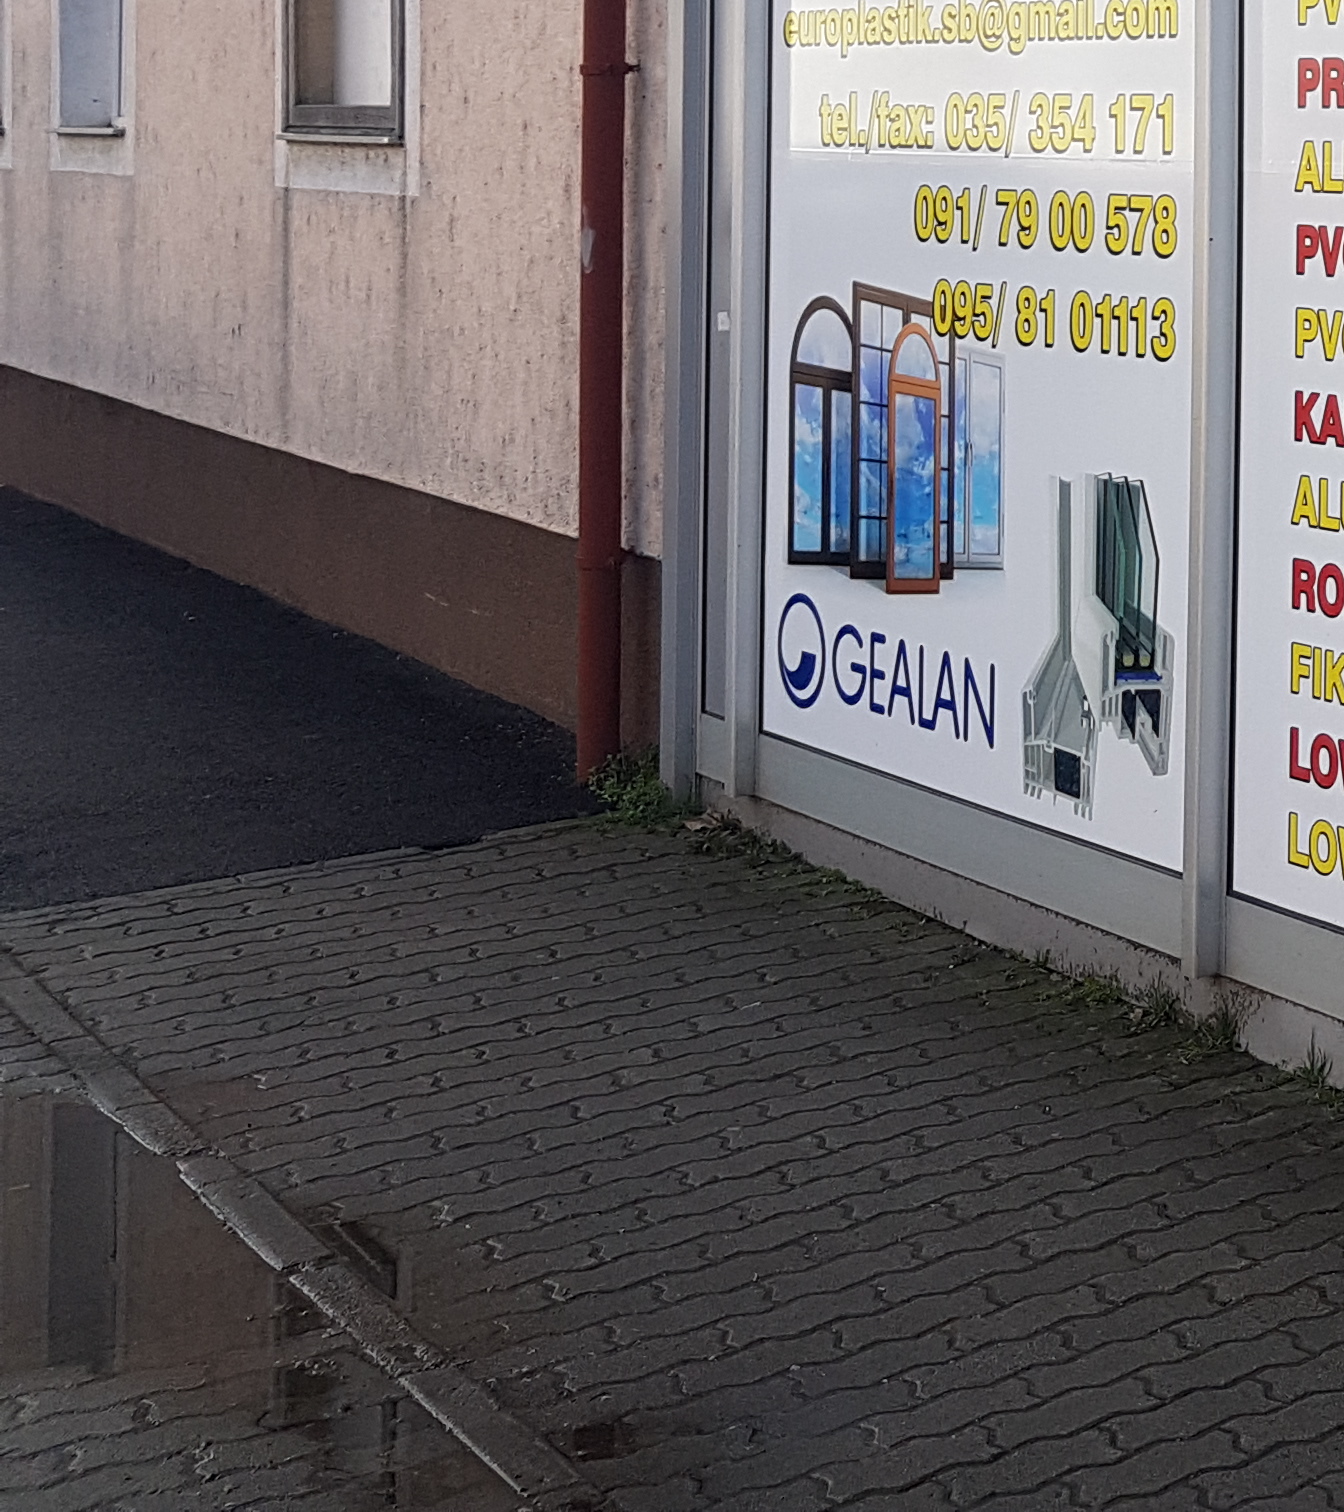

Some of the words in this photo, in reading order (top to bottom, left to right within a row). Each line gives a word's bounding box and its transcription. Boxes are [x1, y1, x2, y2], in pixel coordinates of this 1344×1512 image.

[819, 90, 935, 154] tel./fax:
[944, 90, 1019, 158] 035/
[1028, 92, 1096, 153] 354
[1109, 93, 1175, 155] 171
[914, 184, 988, 251] 091/
[996, 189, 1039, 249] 79
[1049, 190, 1095, 251] 00
[1105, 194, 1178, 258] 578
[932, 279, 1008, 348] 095/
[1016, 286, 1056, 347] 81
[1070, 290, 1176, 361] 01113
[832, 623, 996, 750] GEALAN
